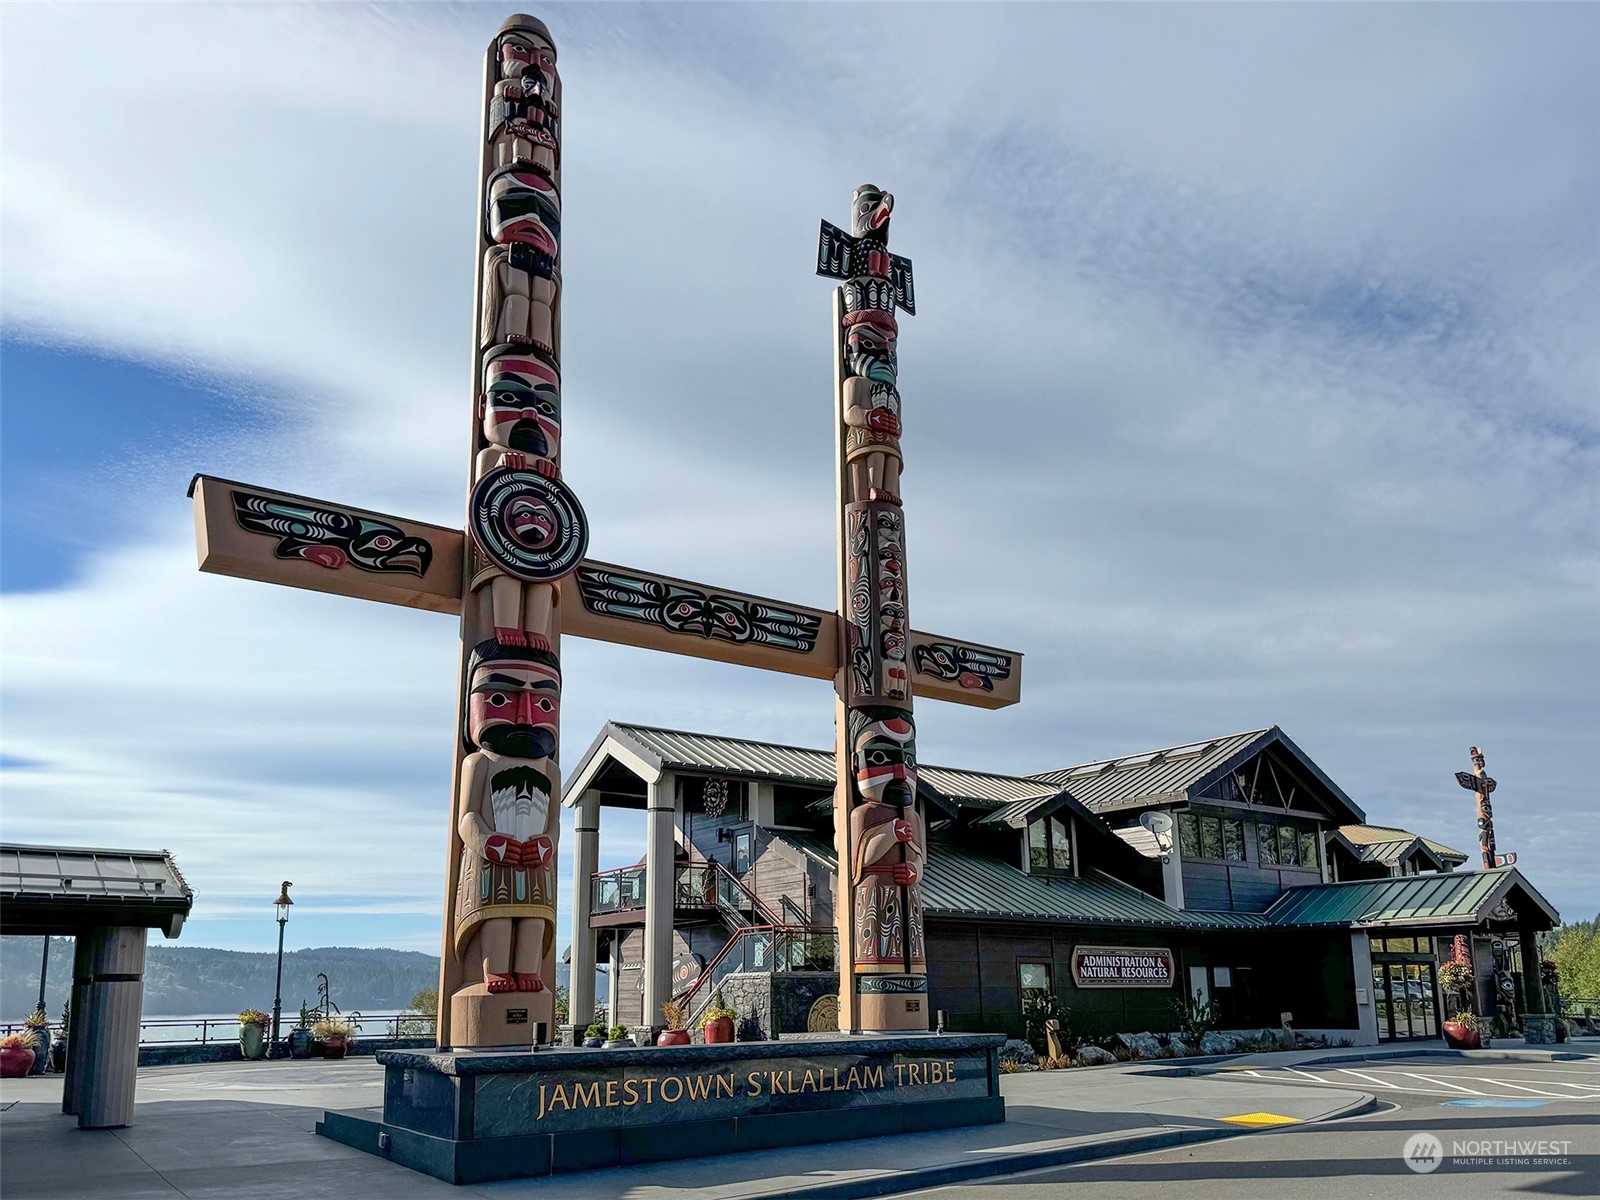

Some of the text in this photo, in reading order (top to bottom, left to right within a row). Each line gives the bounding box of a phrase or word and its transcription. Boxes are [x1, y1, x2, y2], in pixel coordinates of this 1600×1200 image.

[1083, 956, 1164, 967] ADMINISTRATION &
[1080, 967, 1168, 978] NATURAL RESOURCES
[536, 1060, 957, 1120] JAMESTOWN S'KLALLAM TRIBE
